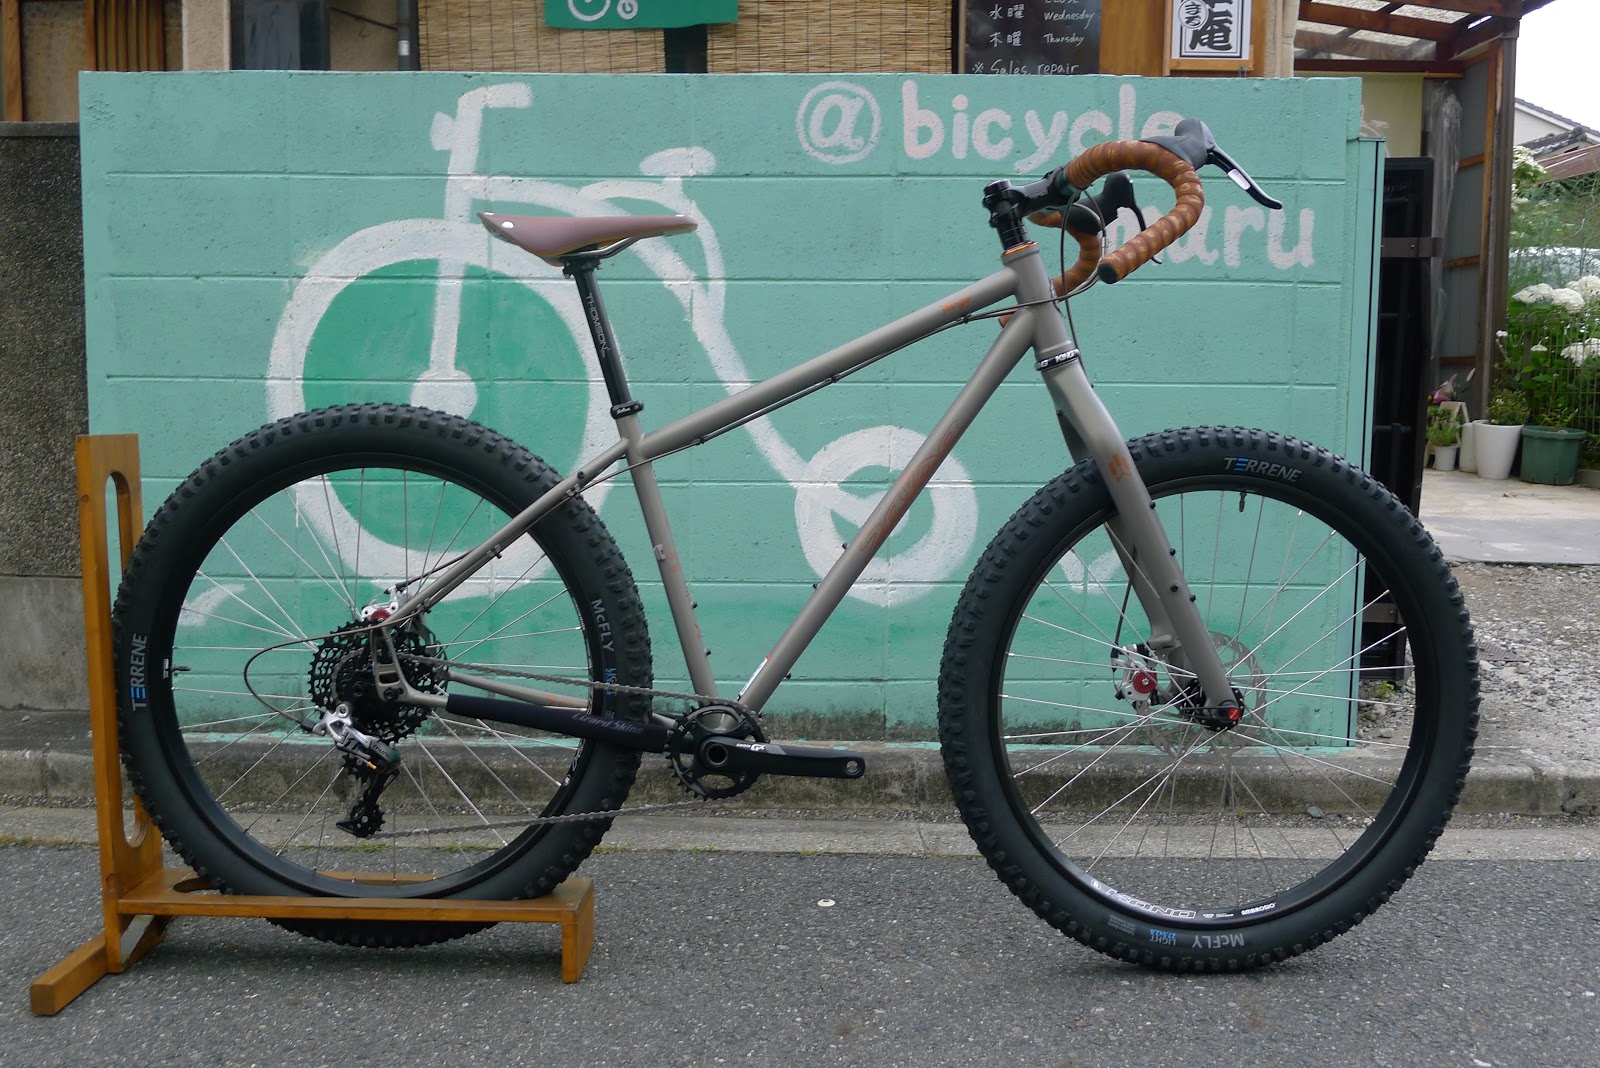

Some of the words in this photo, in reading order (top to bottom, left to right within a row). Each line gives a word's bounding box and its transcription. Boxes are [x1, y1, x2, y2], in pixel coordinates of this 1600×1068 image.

[989, 4, 1025, 20] 水曜
[1044, 9, 1095, 30] Wednesday
[989, 30, 1023, 48] 木曜
[1043, 32, 1085, 47] Thursday
[1037, 62, 1080, 75] repair
[586, 292, 608, 351] THOMSON
[1224, 457, 1302, 482] TERRENE
[592, 599, 615, 652] McFLY
[130, 632, 147, 712] TERRENE
[610, 667, 618, 696] LIGT
[1150, 934, 1176, 946] LIGHT
[1192, 932, 1245, 949] McFLY
